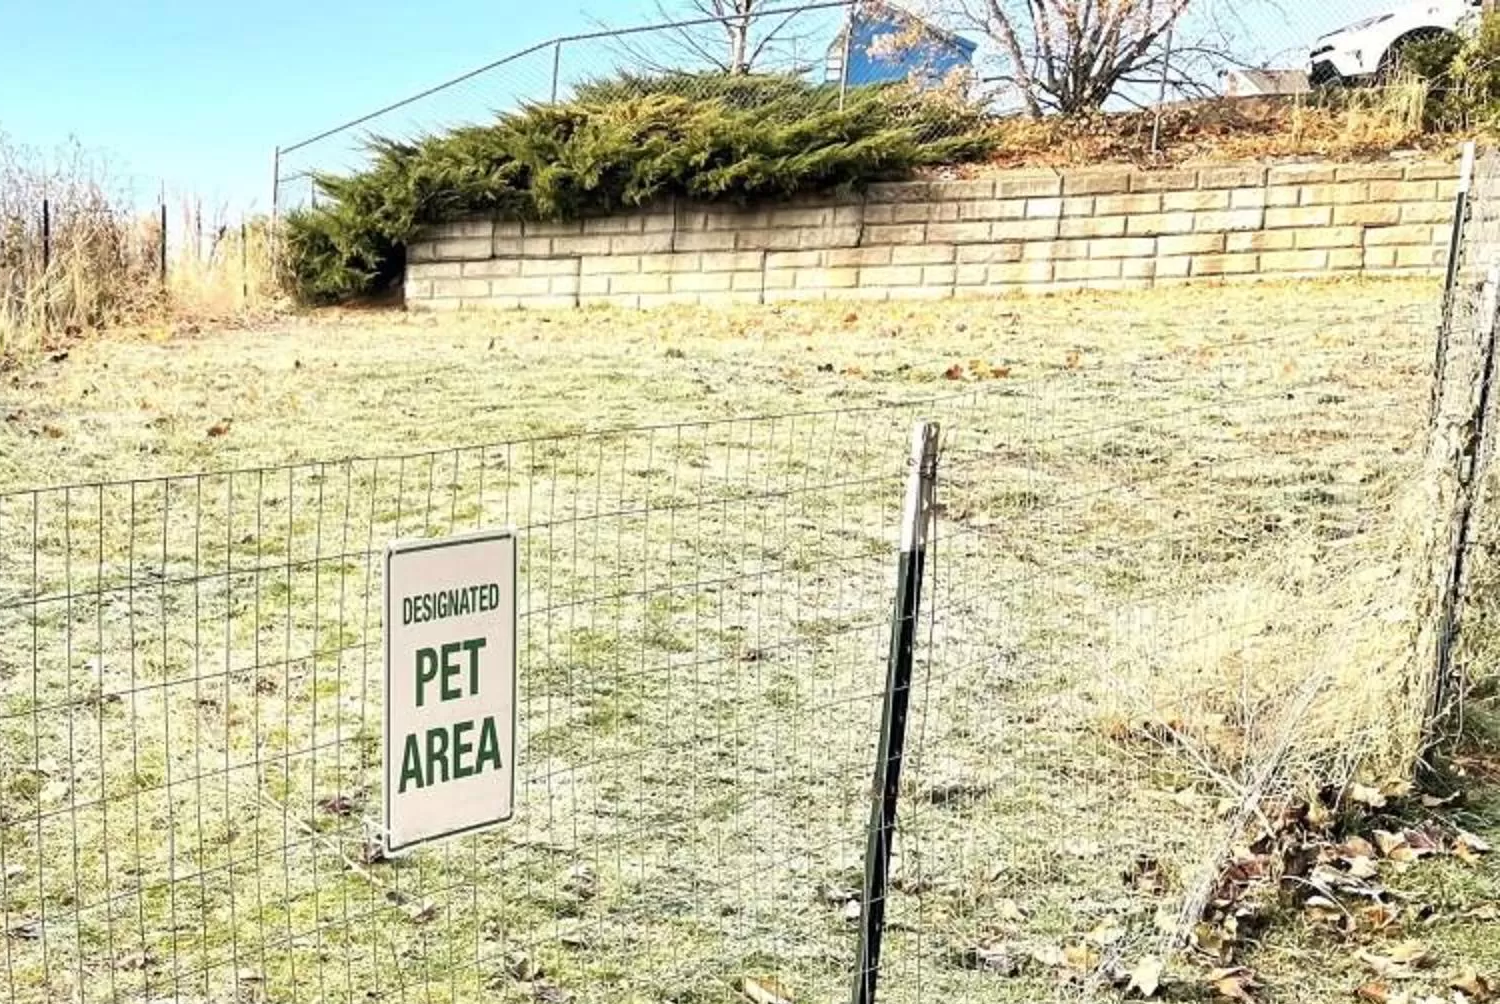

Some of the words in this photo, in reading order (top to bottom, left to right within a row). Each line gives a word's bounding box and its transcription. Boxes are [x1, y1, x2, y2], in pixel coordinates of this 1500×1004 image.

[403, 583, 499, 625] DESIGNATED
[415, 637, 486, 708] PET
[398, 716, 502, 794] AREA
